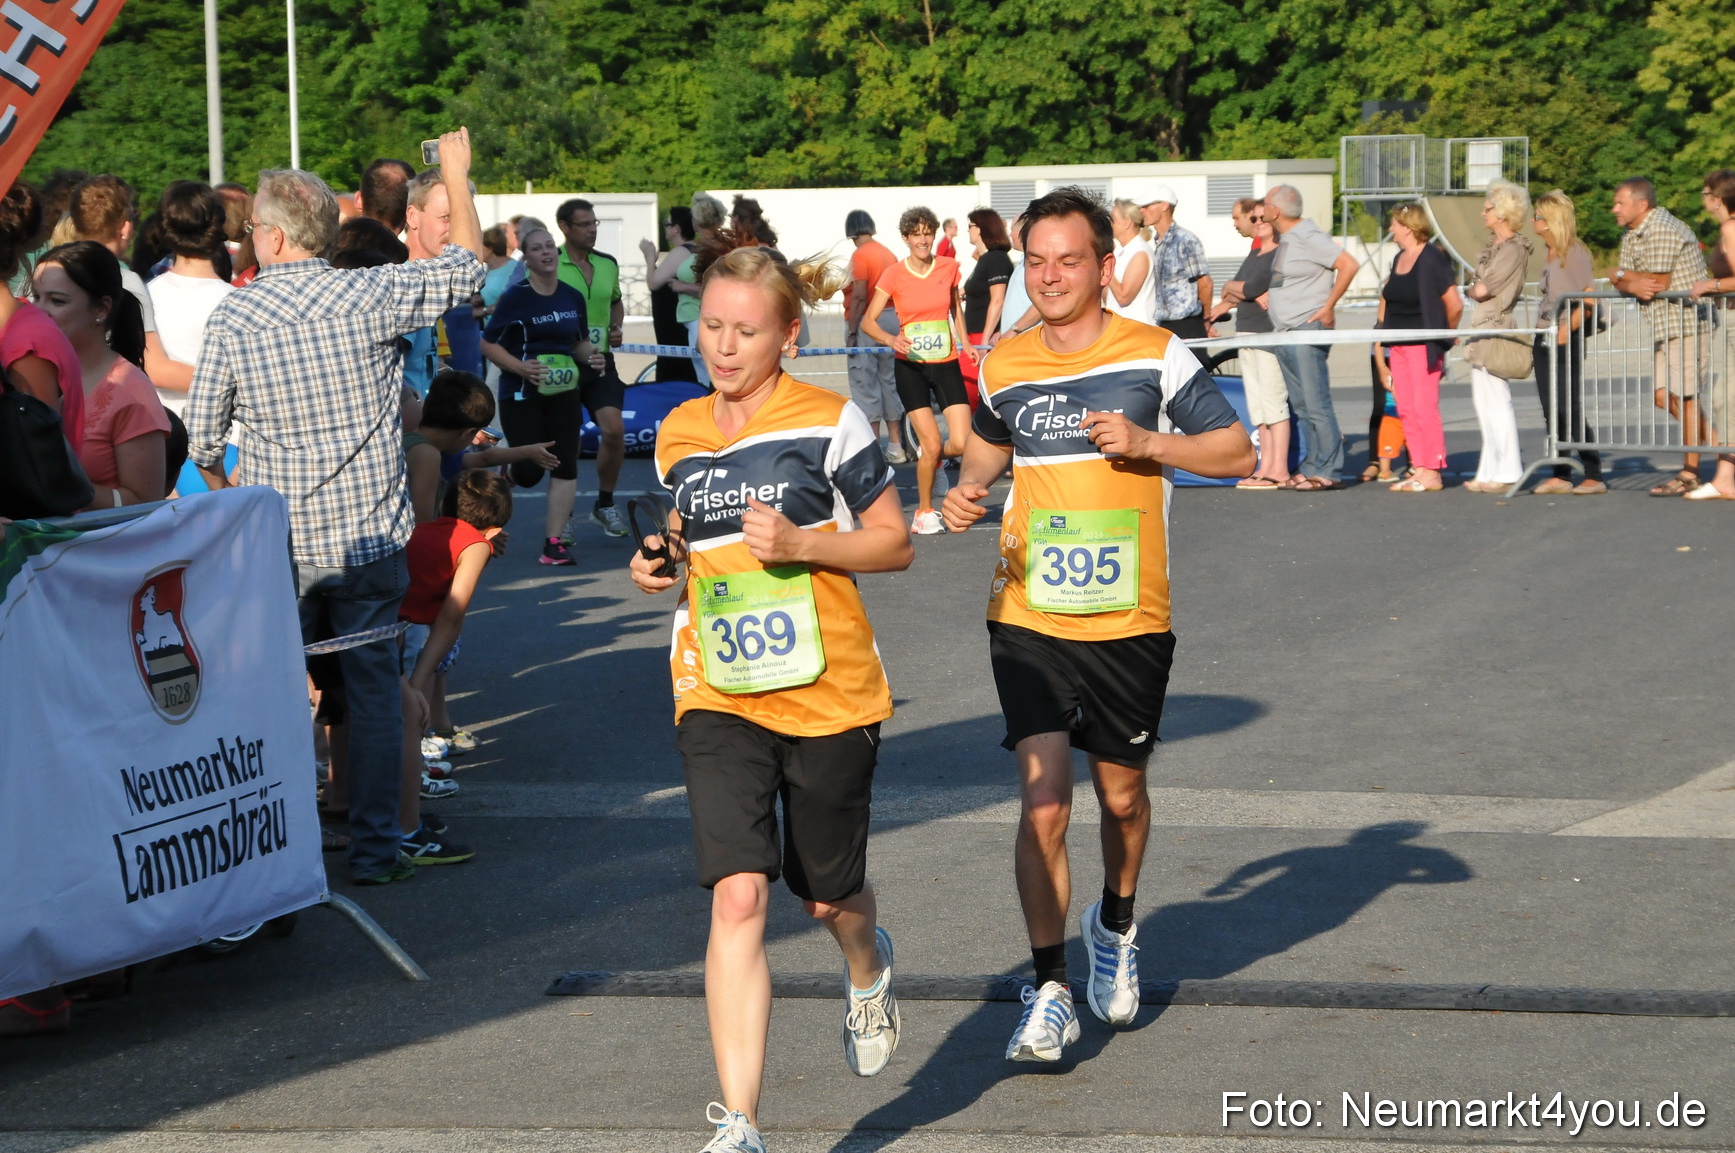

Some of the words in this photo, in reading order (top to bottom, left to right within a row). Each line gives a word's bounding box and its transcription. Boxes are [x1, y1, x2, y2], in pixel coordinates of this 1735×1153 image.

[532, 314, 554, 325] EURO
[559, 310, 577, 319] POLES
[913, 334, 943, 351] 584
[545, 369, 573, 385] 330
[1031, 407, 1124, 431] Fisc
[690, 482, 789, 513] Fischer
[1042, 546, 1121, 587] 395
[711, 610, 796, 664] 369
[724, 676, 742, 684] Fischer
[743, 672, 777, 682] Automobile
[779, 667, 799, 676] GmbH
[731, 664, 760, 674] Stephanie
[761, 660, 787, 669] Ainouz
[164, 682, 191, 709] 1628
[120, 734, 264, 816] Neumarkter
[112, 786, 287, 904] Lammsbräu
